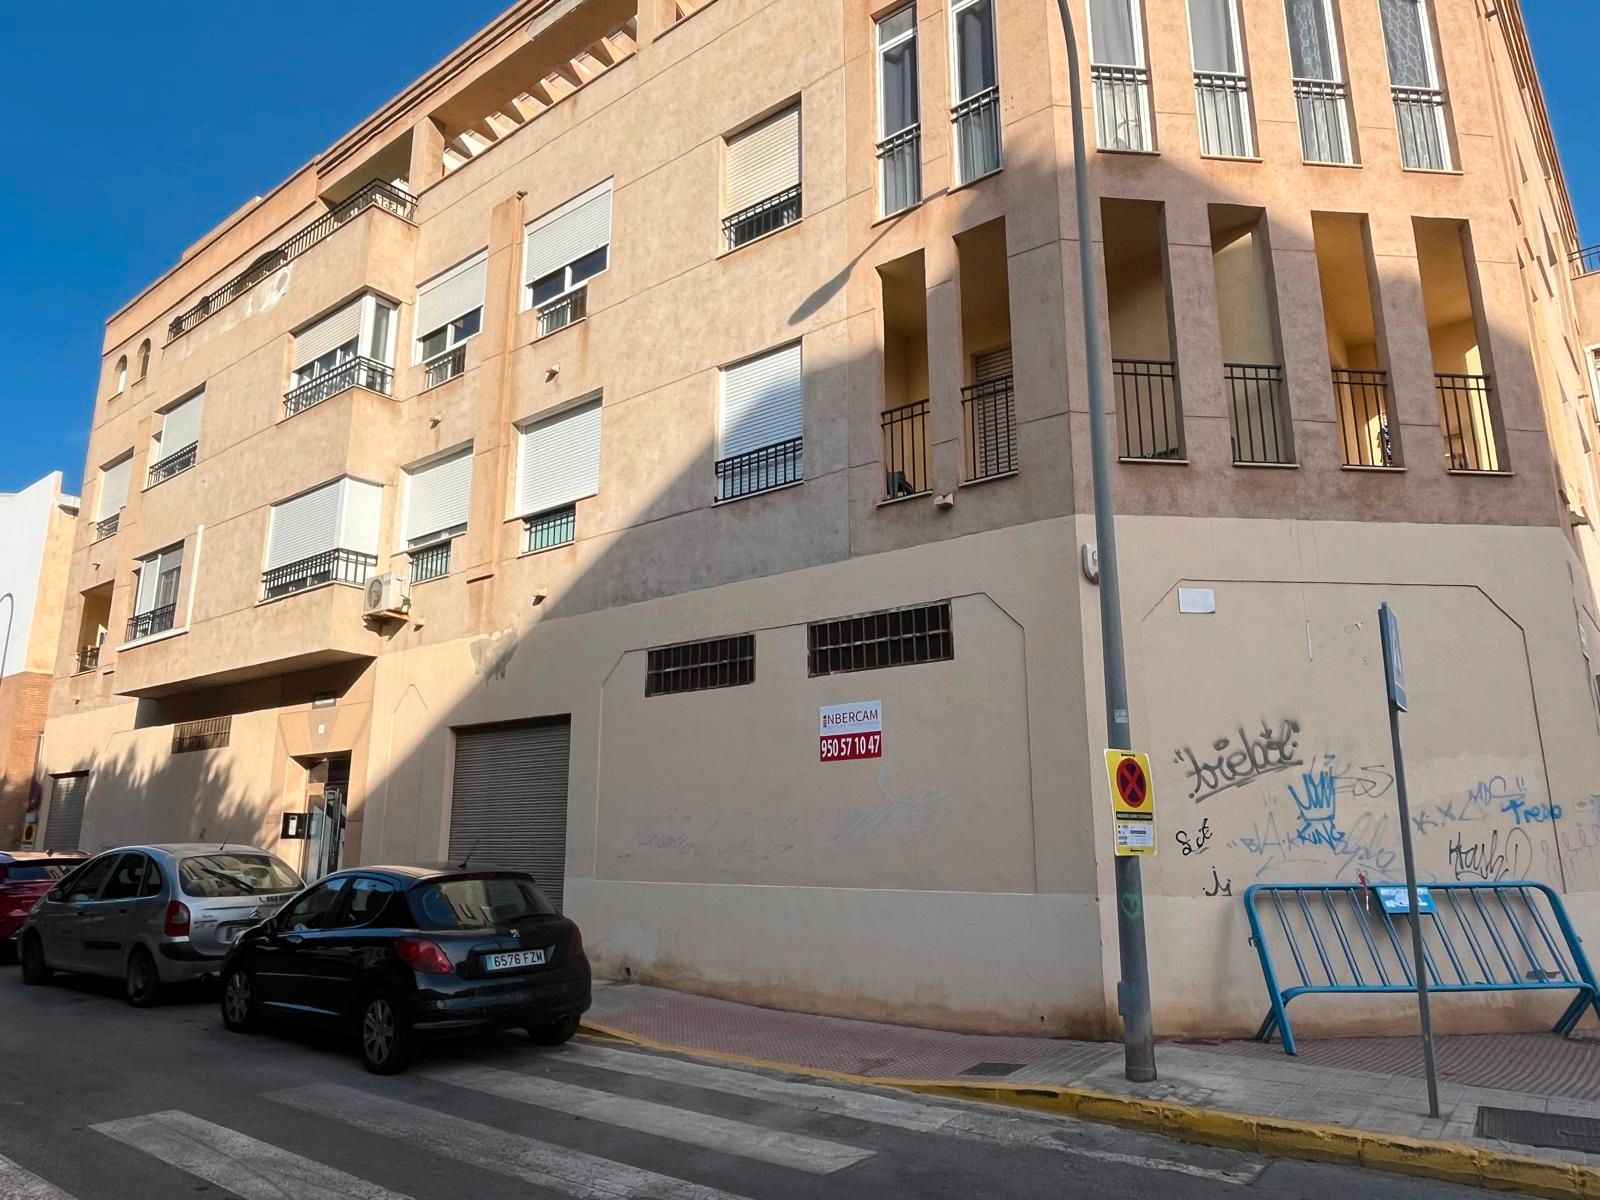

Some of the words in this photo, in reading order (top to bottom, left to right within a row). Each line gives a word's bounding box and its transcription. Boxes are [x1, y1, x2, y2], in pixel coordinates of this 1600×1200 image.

[821, 739, 838, 757] 950
[841, 738, 852, 756] 57
[855, 736, 866, 754] 10
[868, 735, 879, 753] 47
[494, 954, 520, 967] 6576
[523, 952, 543, 964] FZM
